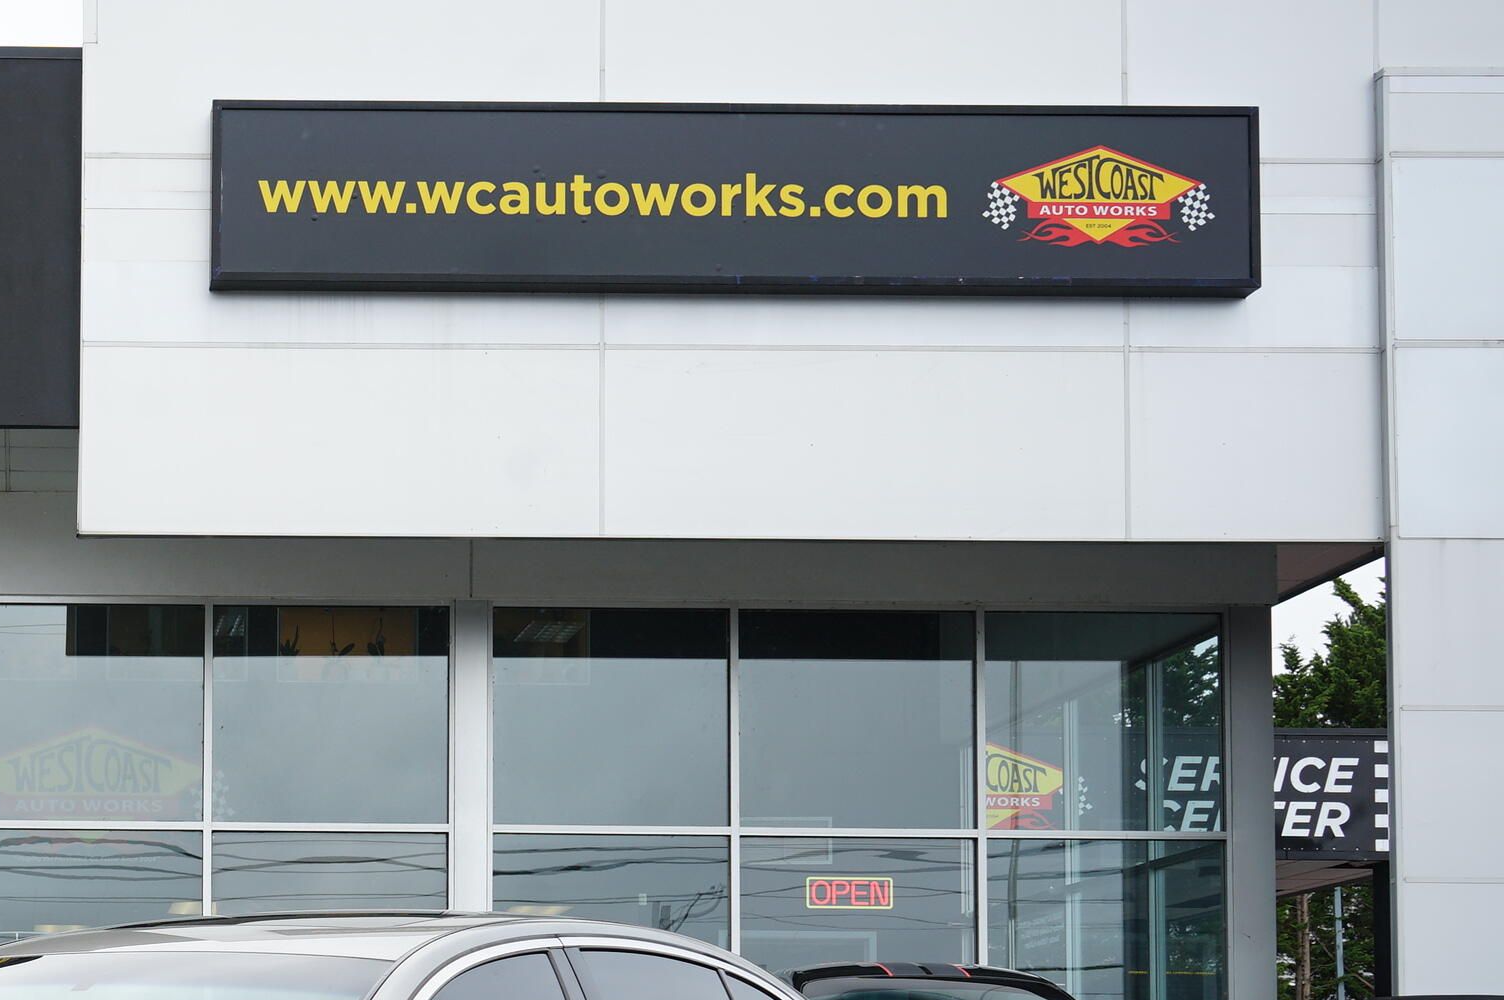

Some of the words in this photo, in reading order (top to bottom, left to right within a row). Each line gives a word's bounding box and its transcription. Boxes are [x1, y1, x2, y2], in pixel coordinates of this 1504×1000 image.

[258, 173, 948, 218] www.wcautoworks.com
[1039, 205, 1089, 217] AUTO
[1093, 205, 1158, 217] WORKS
[15, 800, 79, 813] AUTO
[84, 799, 163, 813] WORKS
[811, 880, 889, 906] OPEN
